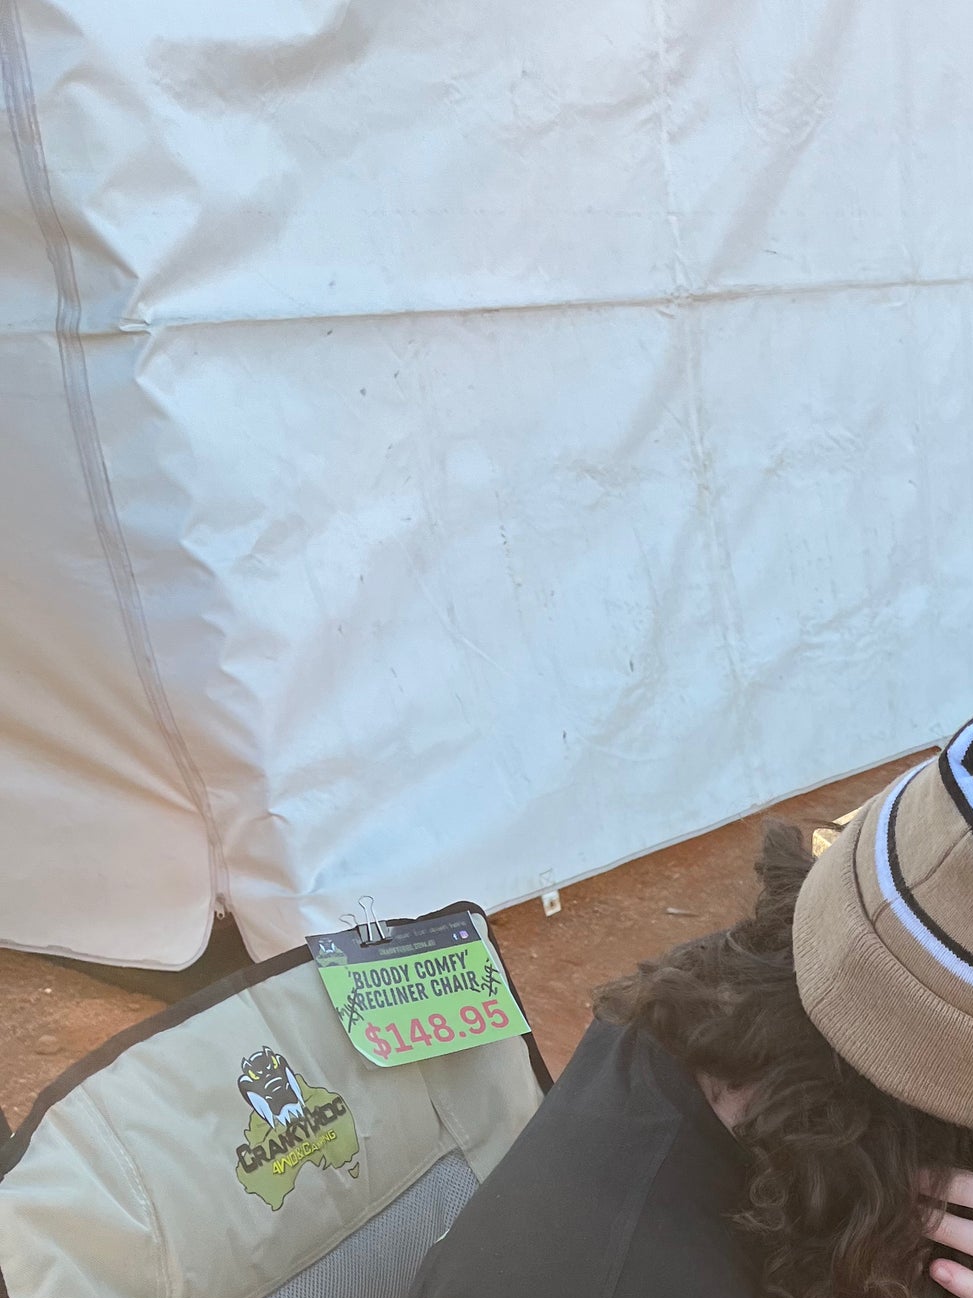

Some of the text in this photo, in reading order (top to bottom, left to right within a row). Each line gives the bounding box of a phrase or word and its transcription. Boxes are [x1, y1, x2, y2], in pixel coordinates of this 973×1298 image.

[356, 981, 429, 1011] RECLINER
[430, 970, 480, 999] CHAIR
[364, 999, 510, 1060] $148.95
